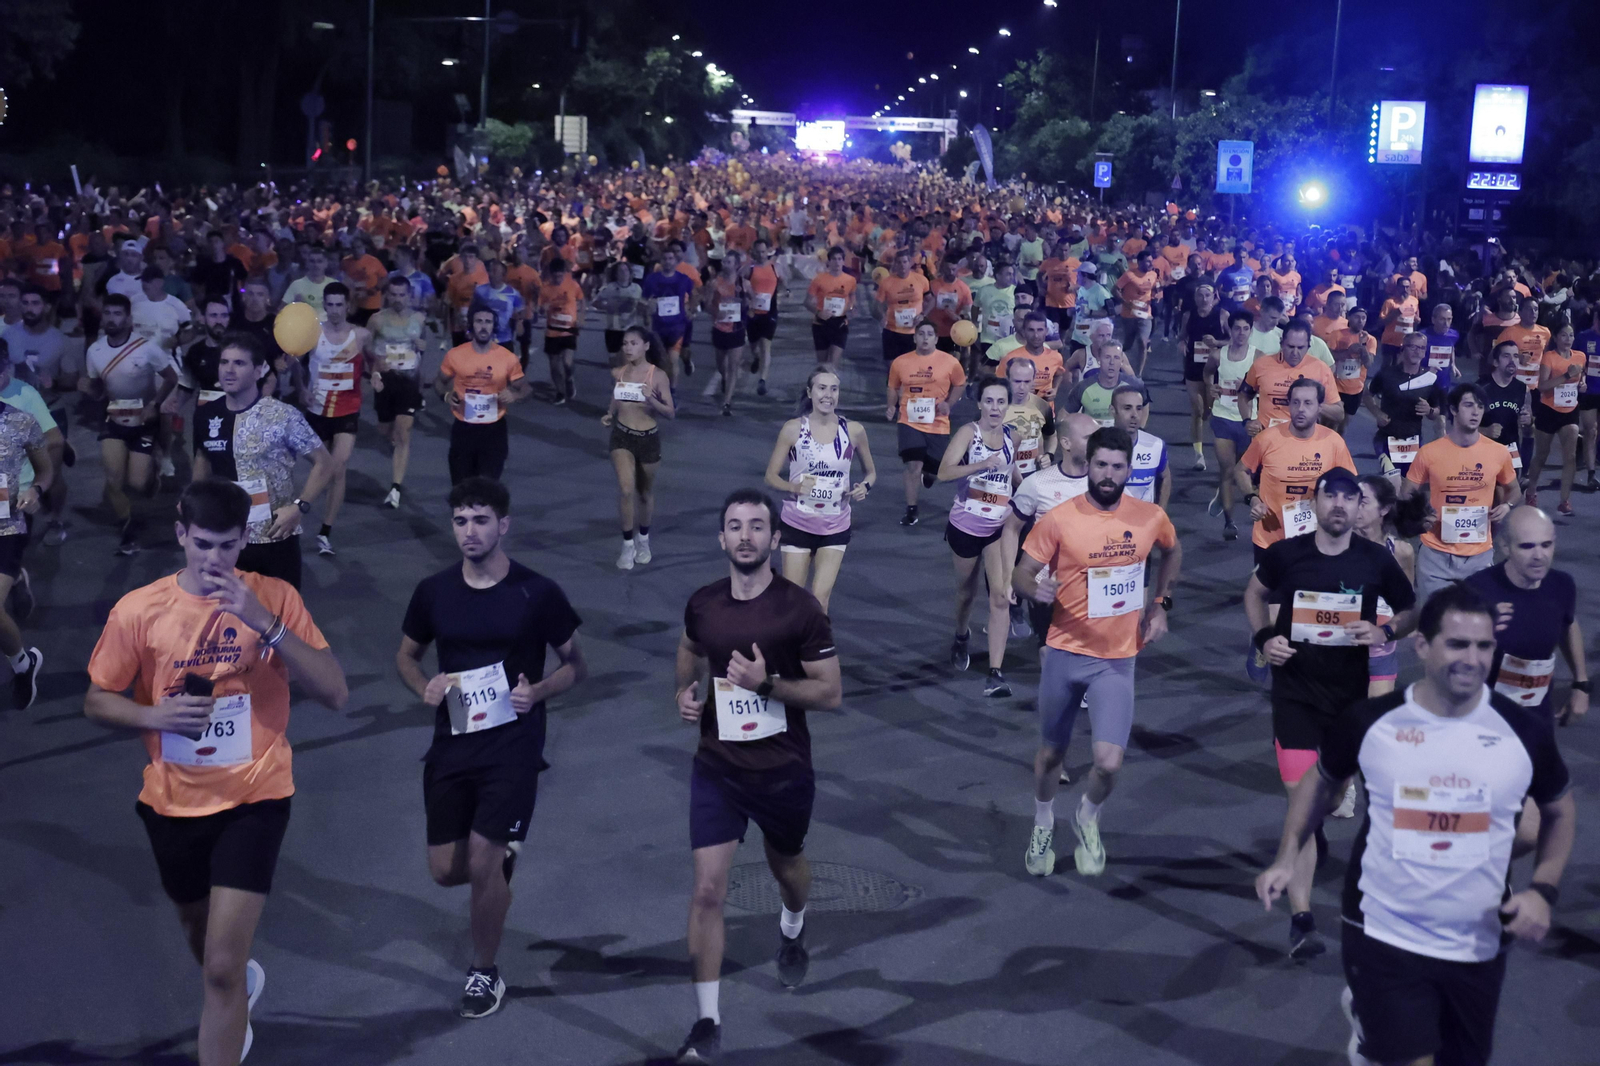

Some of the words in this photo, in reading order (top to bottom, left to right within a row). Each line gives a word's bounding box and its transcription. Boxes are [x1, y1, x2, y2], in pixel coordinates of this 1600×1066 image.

[1390, 106, 1416, 142] P
[1401, 134, 1415, 142] 24h
[1384, 152, 1409, 162] saba
[1098, 164, 1108, 176] P
[1470, 173, 1517, 187] 22:02
[1396, 445, 1412, 453] 1017
[1135, 453, 1152, 461] ACS
[811, 489, 833, 500] 5303
[982, 493, 998, 504] 830
[1293, 510, 1312, 523] 6293
[1455, 519, 1478, 528] 6294
[1103, 543, 1136, 551] NOCTURNA
[1088, 551, 1119, 559] SEVILLA
[1102, 580, 1136, 596] 15019
[1315, 611, 1340, 625] 695
[194, 646, 242, 656] NOCTURNA
[173, 656, 215, 669] SEVILLA
[457, 686, 497, 708] 15119
[728, 697, 769, 715] 15117
[204, 720, 236, 738] 763
[1395, 727, 1425, 747] edp
[1427, 811, 1461, 832] 707
